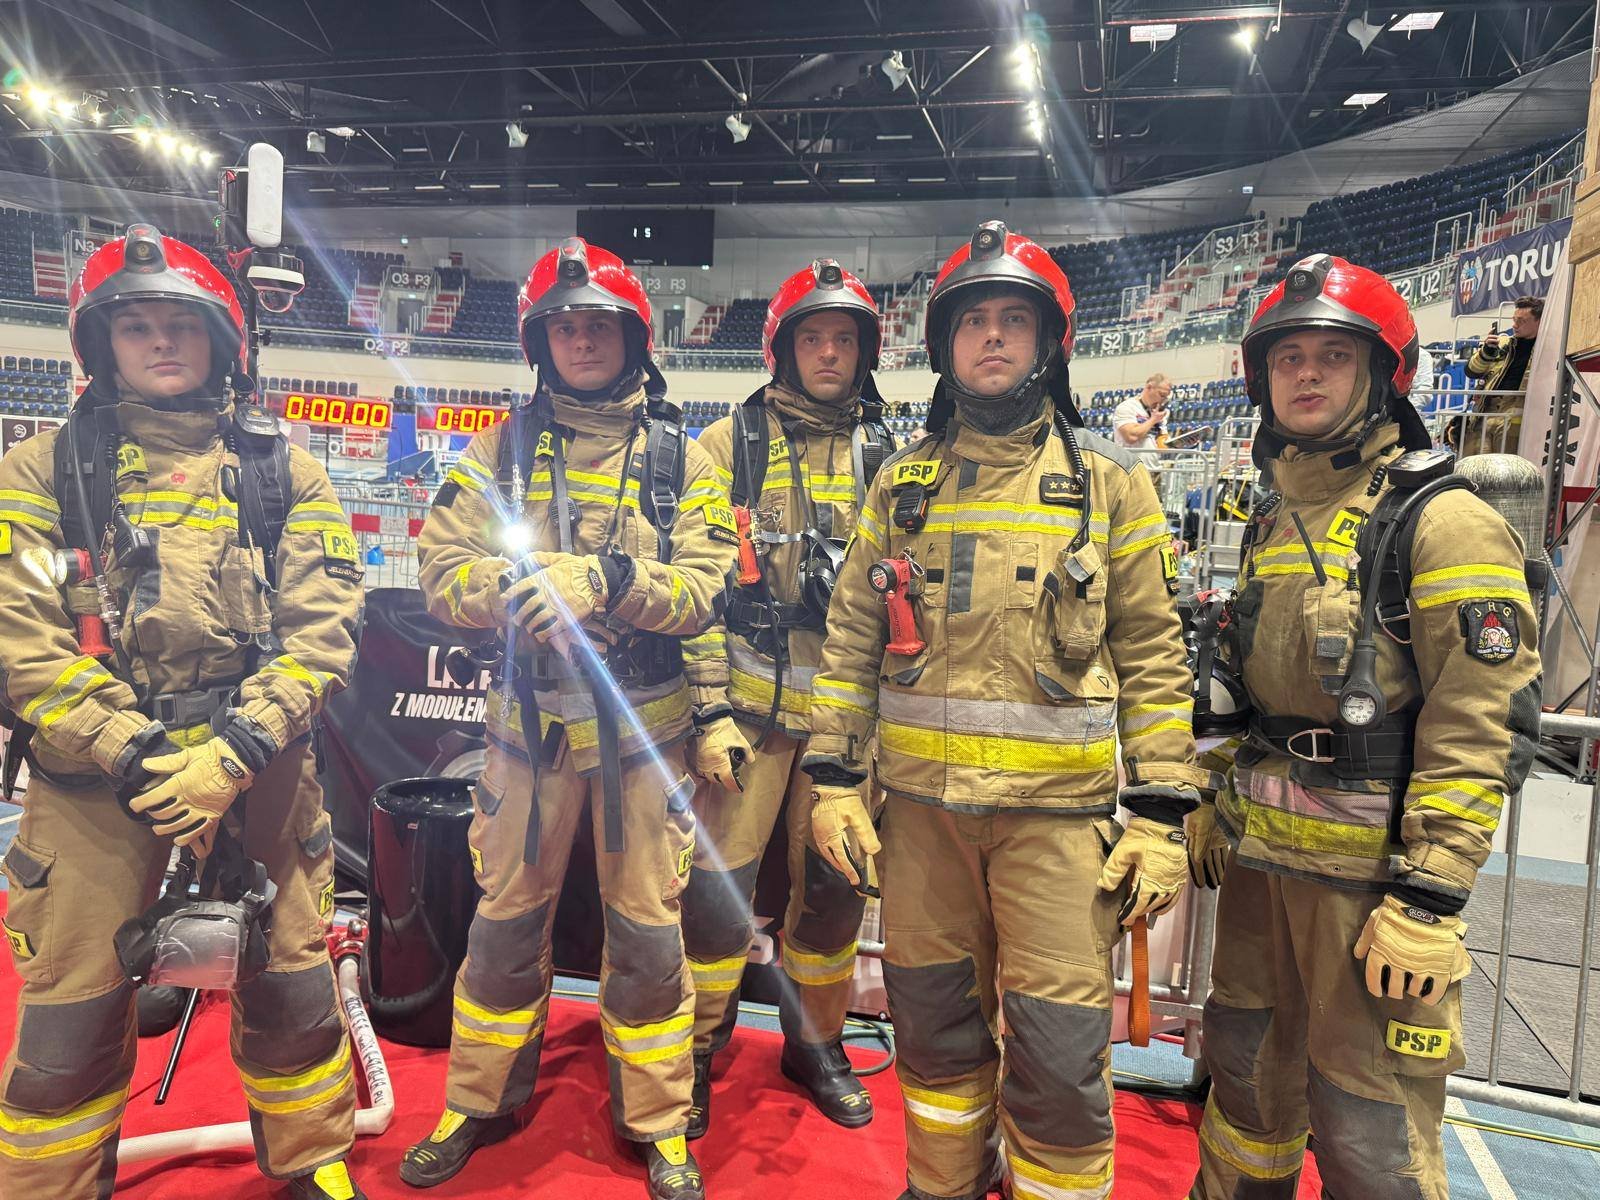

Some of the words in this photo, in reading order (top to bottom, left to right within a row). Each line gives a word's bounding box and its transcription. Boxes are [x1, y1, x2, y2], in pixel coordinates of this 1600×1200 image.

[75, 239, 95, 252] N3
[1216, 236, 1233, 254] S3
[1242, 231, 1260, 249] T3
[1485, 238, 1569, 291] TORU
[392, 272, 409, 284] O3
[646, 278, 661, 291] P3
[670, 278, 687, 291] R3
[1421, 270, 1441, 297] U2
[1102, 334, 1121, 351] S2
[1130, 330, 1146, 347] T2
[286, 395, 389, 427] 0:00.00
[435, 408, 510, 432] 0:00
[117, 448, 140, 469] SP
[769, 440, 787, 457] SP
[898, 464, 934, 480] PSP
[710, 506, 734, 526] PSP
[1335, 517, 1362, 541] PS
[390, 692, 405, 717] Z
[1395, 1028, 1442, 1053] PSP
